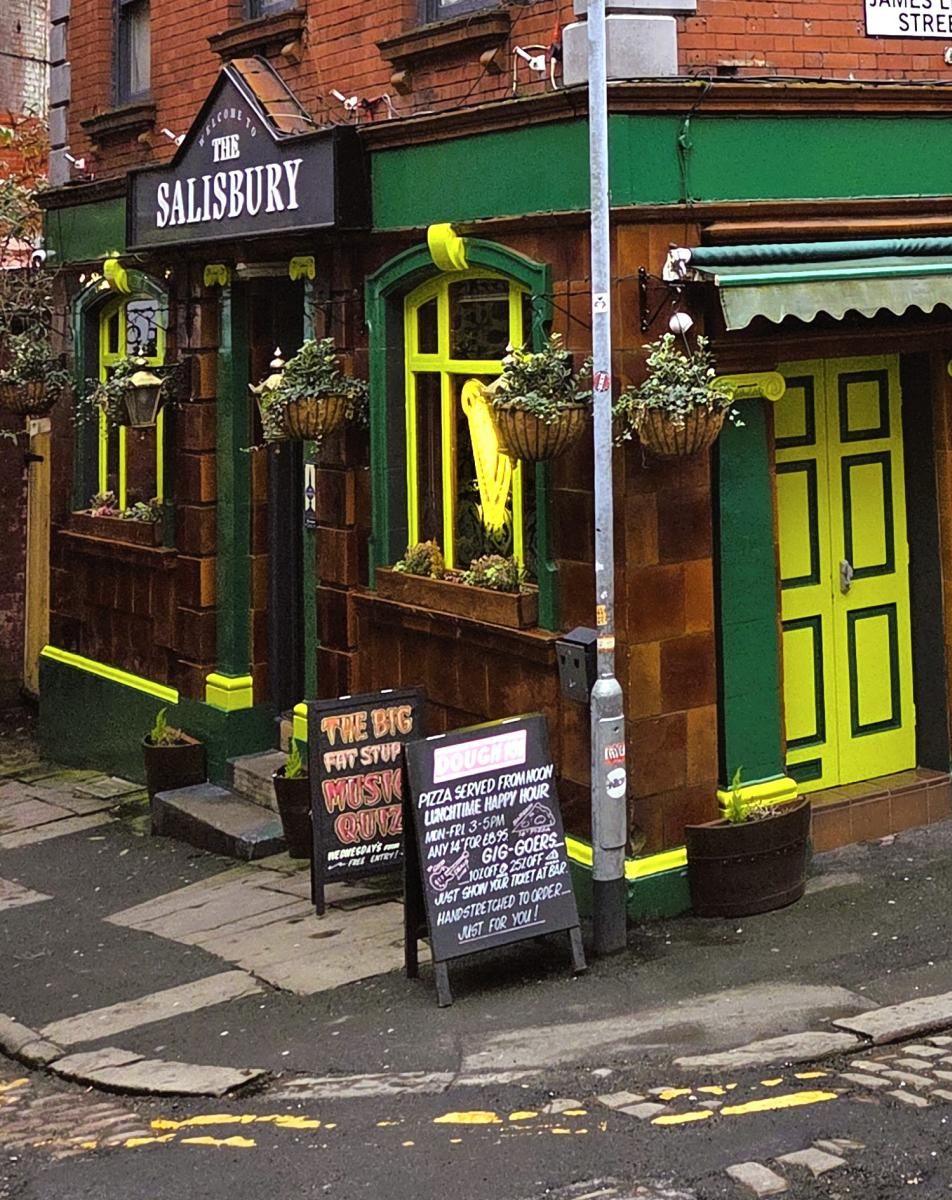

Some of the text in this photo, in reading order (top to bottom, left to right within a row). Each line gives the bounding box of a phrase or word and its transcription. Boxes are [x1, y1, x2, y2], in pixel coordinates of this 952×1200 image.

[211, 134, 240, 163] THE
[156, 158, 304, 228] SALISBURY
[321, 705, 413, 746] THE BIG
[323, 748, 359, 773] FAT
[435, 742, 503, 775] DOUGH
[418, 763, 554, 809] PIZZA SERVED FROM NOON
[424, 783, 550, 827] LUNCHTIME HAPPY HOUR
[424, 823, 466, 844] MON-FRI
[468, 813, 506, 834] 3-5PM
[427, 842, 449, 860] ANY
[463, 834, 482, 852] FOR
[434, 888, 461, 906] JUST
[462, 881, 489, 900] SHOW
[489, 876, 510, 894] YOUR
[510, 870, 536, 887] TICKET
[535, 866, 548, 881] AT
[436, 894, 516, 926] HANDSTRETCHED
[518, 890, 530, 906] TO
[457, 920, 484, 940] JUST
[488, 915, 508, 932] FOR
